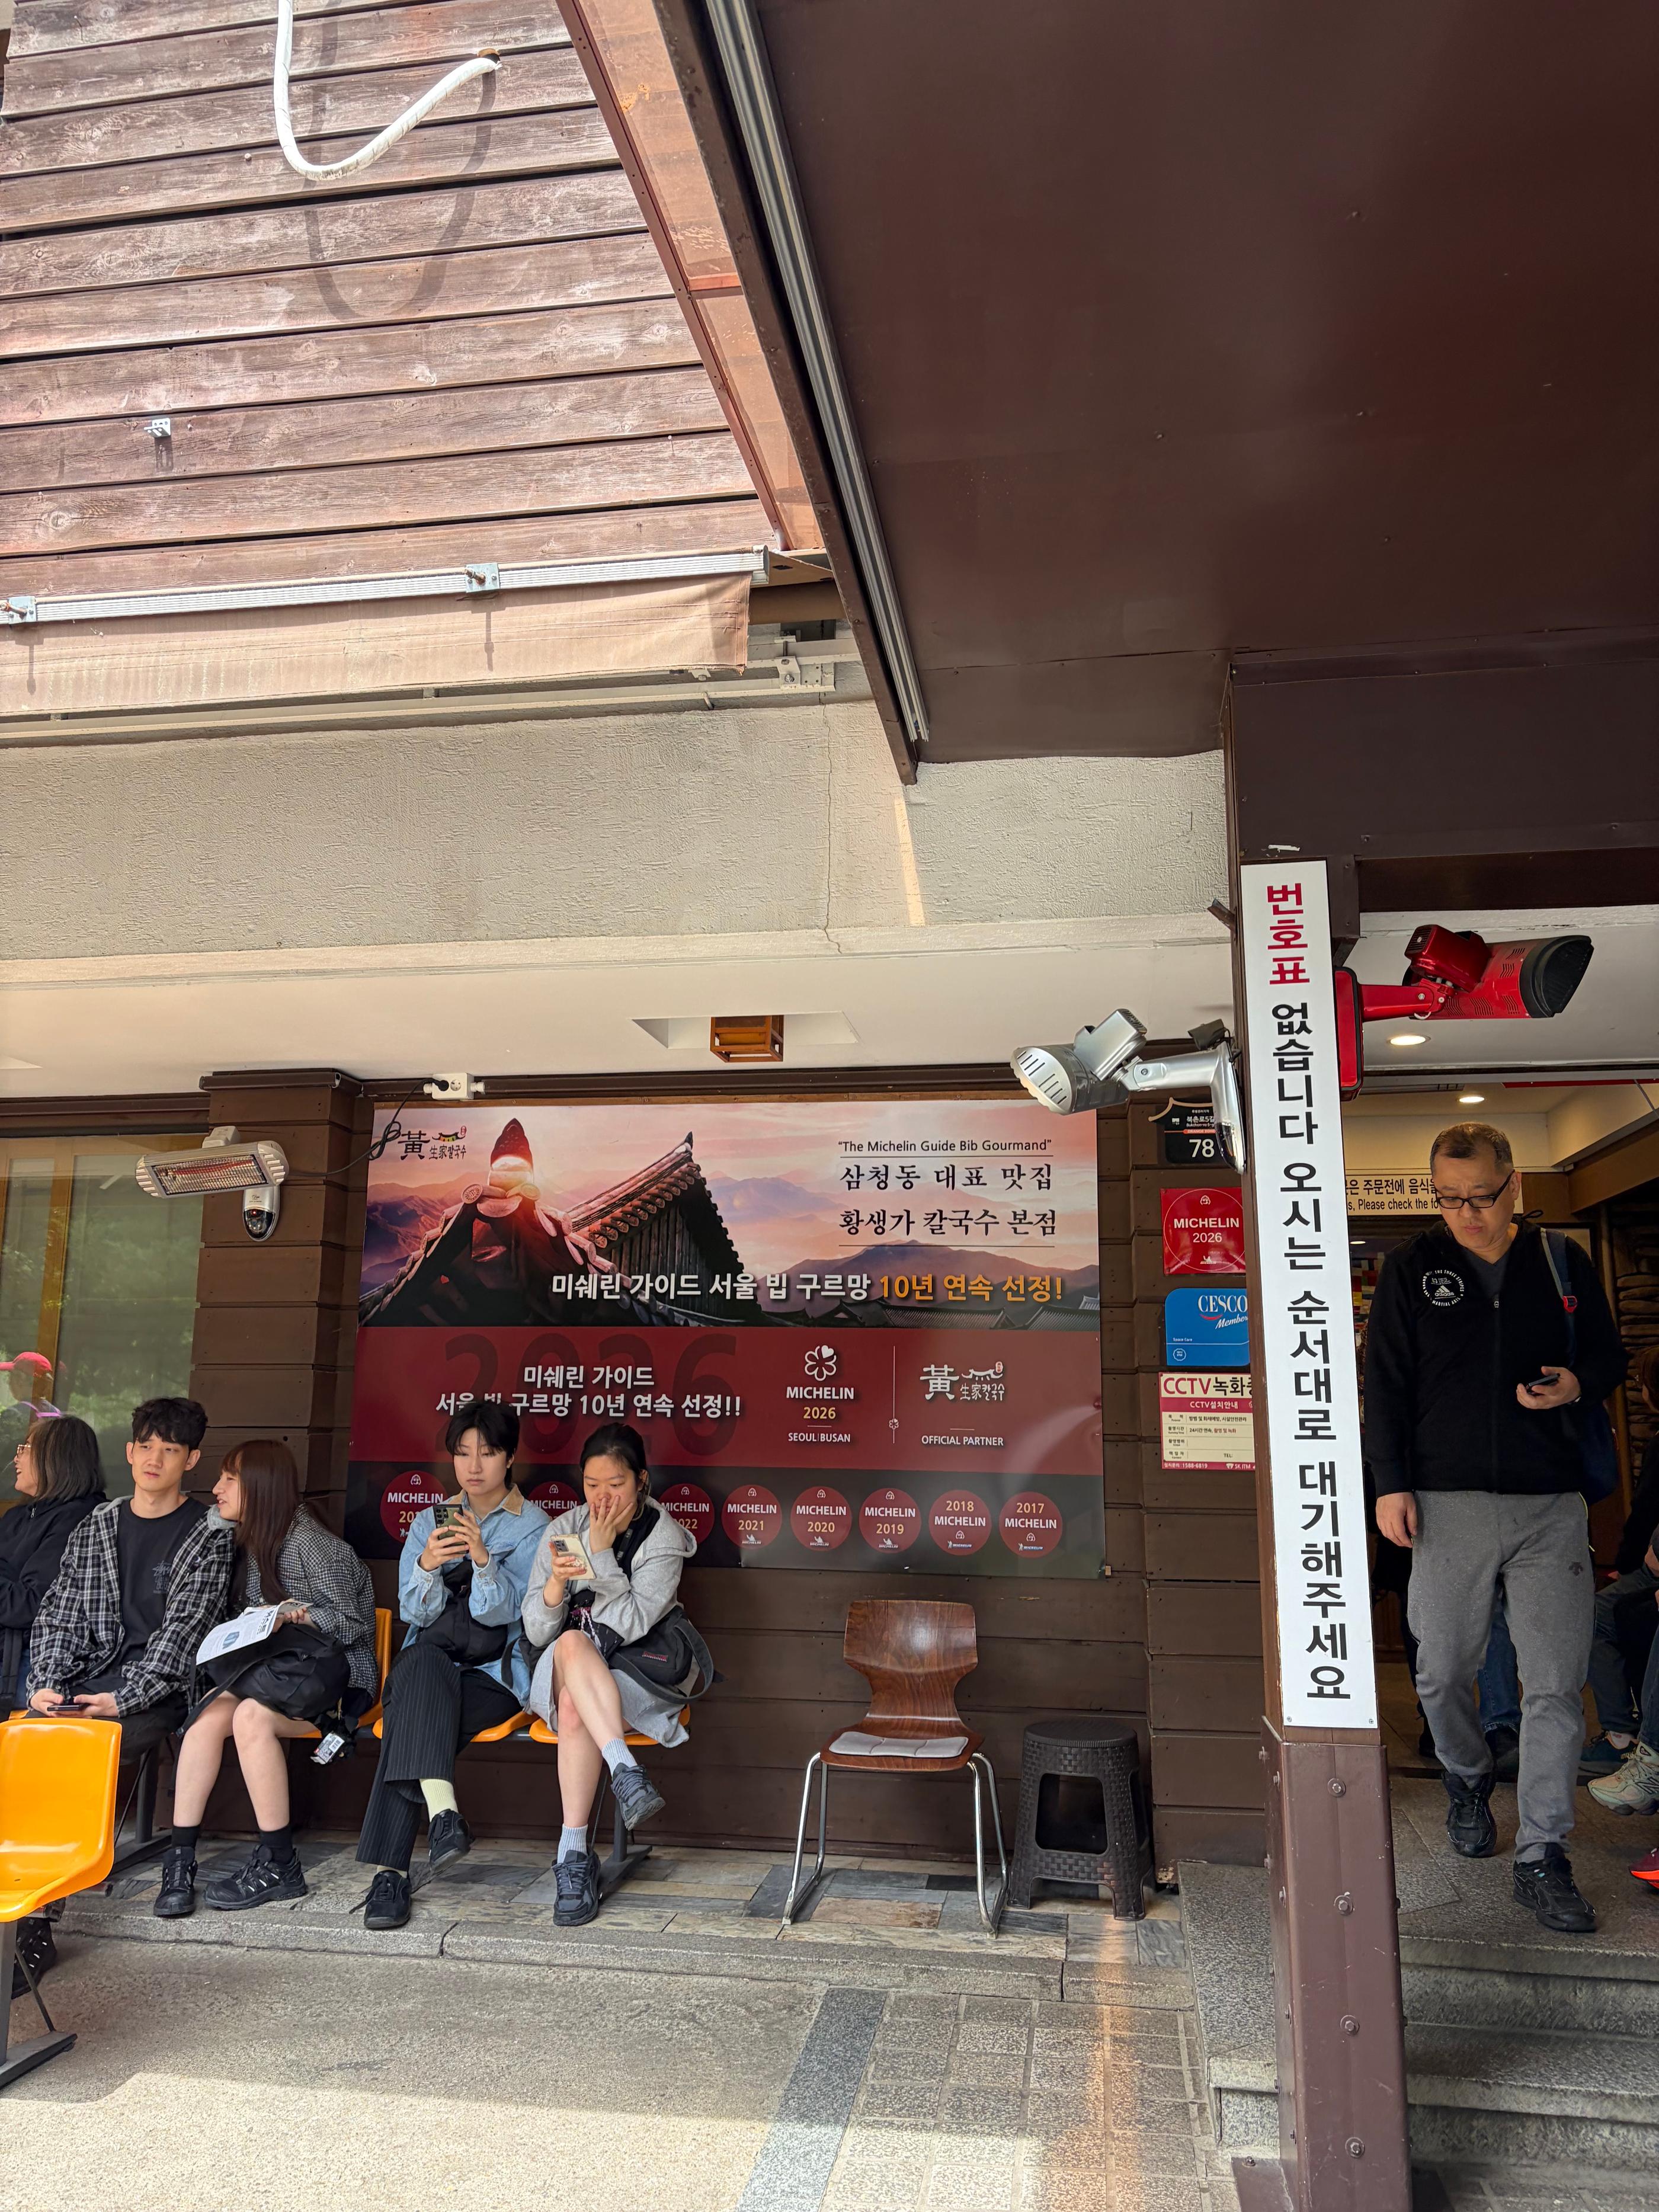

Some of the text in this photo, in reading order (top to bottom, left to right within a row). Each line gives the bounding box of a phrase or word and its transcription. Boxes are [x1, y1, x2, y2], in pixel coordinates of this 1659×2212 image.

[867, 1141, 917, 1151] Michelin
[921, 1141, 956, 1151] Guide
[960, 1141, 978, 1151] Bib
[1189, 1139, 1215, 1158] 78
[840, 1164, 1051, 1190] 삼청동 대표 맛집
[1363, 1179, 1405, 1195] 주문전에
[1358, 1199, 1385, 1210] Please
[1388, 1198, 1413, 1209] check
[1415, 1198, 1428, 1209] the
[839, 1209, 1056, 1235] 황생가 칼국수 본점
[1174, 1218, 1240, 1228] MICHELIN
[1193, 1233, 1222, 1243] 2026
[552, 1273, 1062, 1302] 미쉐린 가이드 서울 빕 구르망 10년 연속 선정!
[1266, 883, 1351, 1700] 번호표 없습니다 오시는 순서대로 대기해주세요
[1198, 1295, 1248, 1313] CESCO
[524, 1366, 655, 1389] 미쉐린 가이드
[786, 1386, 854, 1400] MICHELIN
[509, 1394, 572, 1417] 구르망
[580, 1395, 625, 1417] 10년
[633, 1394, 675, 1417] 연속
[681, 1395, 741, 1419] 선정!!
[803, 1407, 836, 1420] 2026
[921, 1435, 1004, 1446] OFFICIAL PARTNER
[387, 1493, 443, 1503] MICHELIN
[727, 1504, 777, 1514] MICHELIN
[796, 1505, 847, 1516] MICHELIN
[946, 1500, 975, 1512] 2018
[1016, 1502, 1045, 1513] 2017
[399, 1511, 419, 1523] 20
[864, 1507, 915, 1518] MICHELIN
[674, 1518, 697, 1529] 022
[738, 1520, 764, 1531] 2021
[808, 1522, 835, 1532] 2020
[934, 1516, 986, 1526] MICHELIN
[1005, 1518, 1057, 1529] MICHELIN
[876, 1523, 904, 1535] 2019
